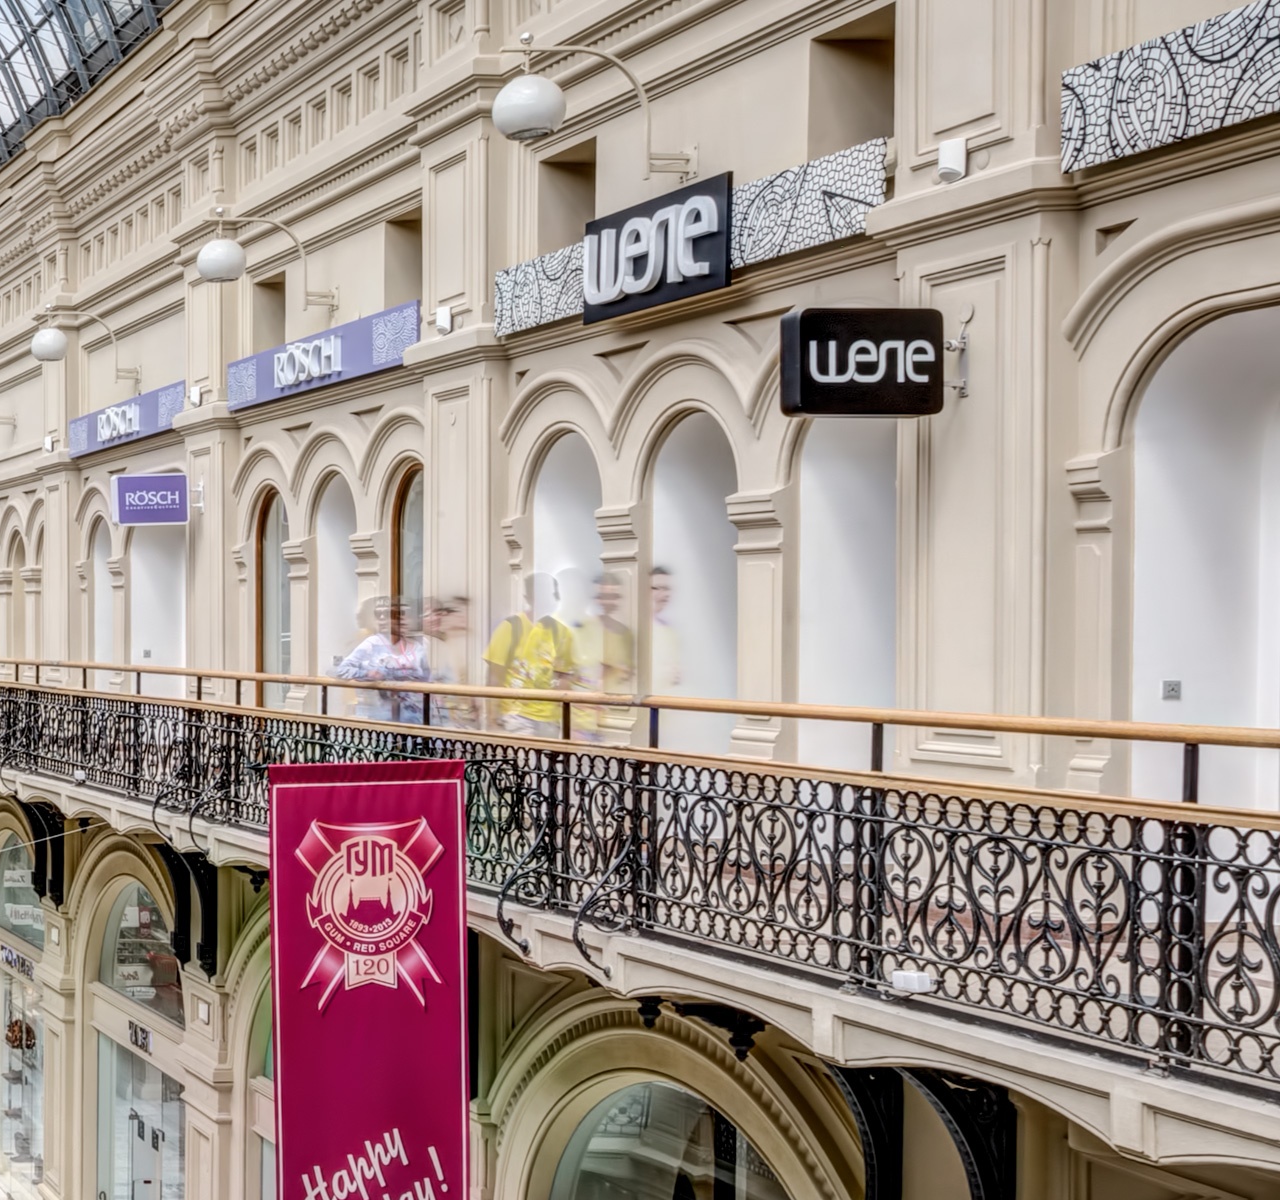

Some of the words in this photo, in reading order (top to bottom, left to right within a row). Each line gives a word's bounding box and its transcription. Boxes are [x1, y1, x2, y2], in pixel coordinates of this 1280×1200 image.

[273, 334, 343, 389] RÖSCH
[97, 402, 140, 442] RÖSCH
[125, 489, 180, 506] RÖSCH
[346, 839, 394, 877] ГУМ
[323, 921, 345, 946] GUM
[352, 943, 377, 954] RED
[378, 918, 417, 952] SQUARE
[352, 957, 390, 977] 120
